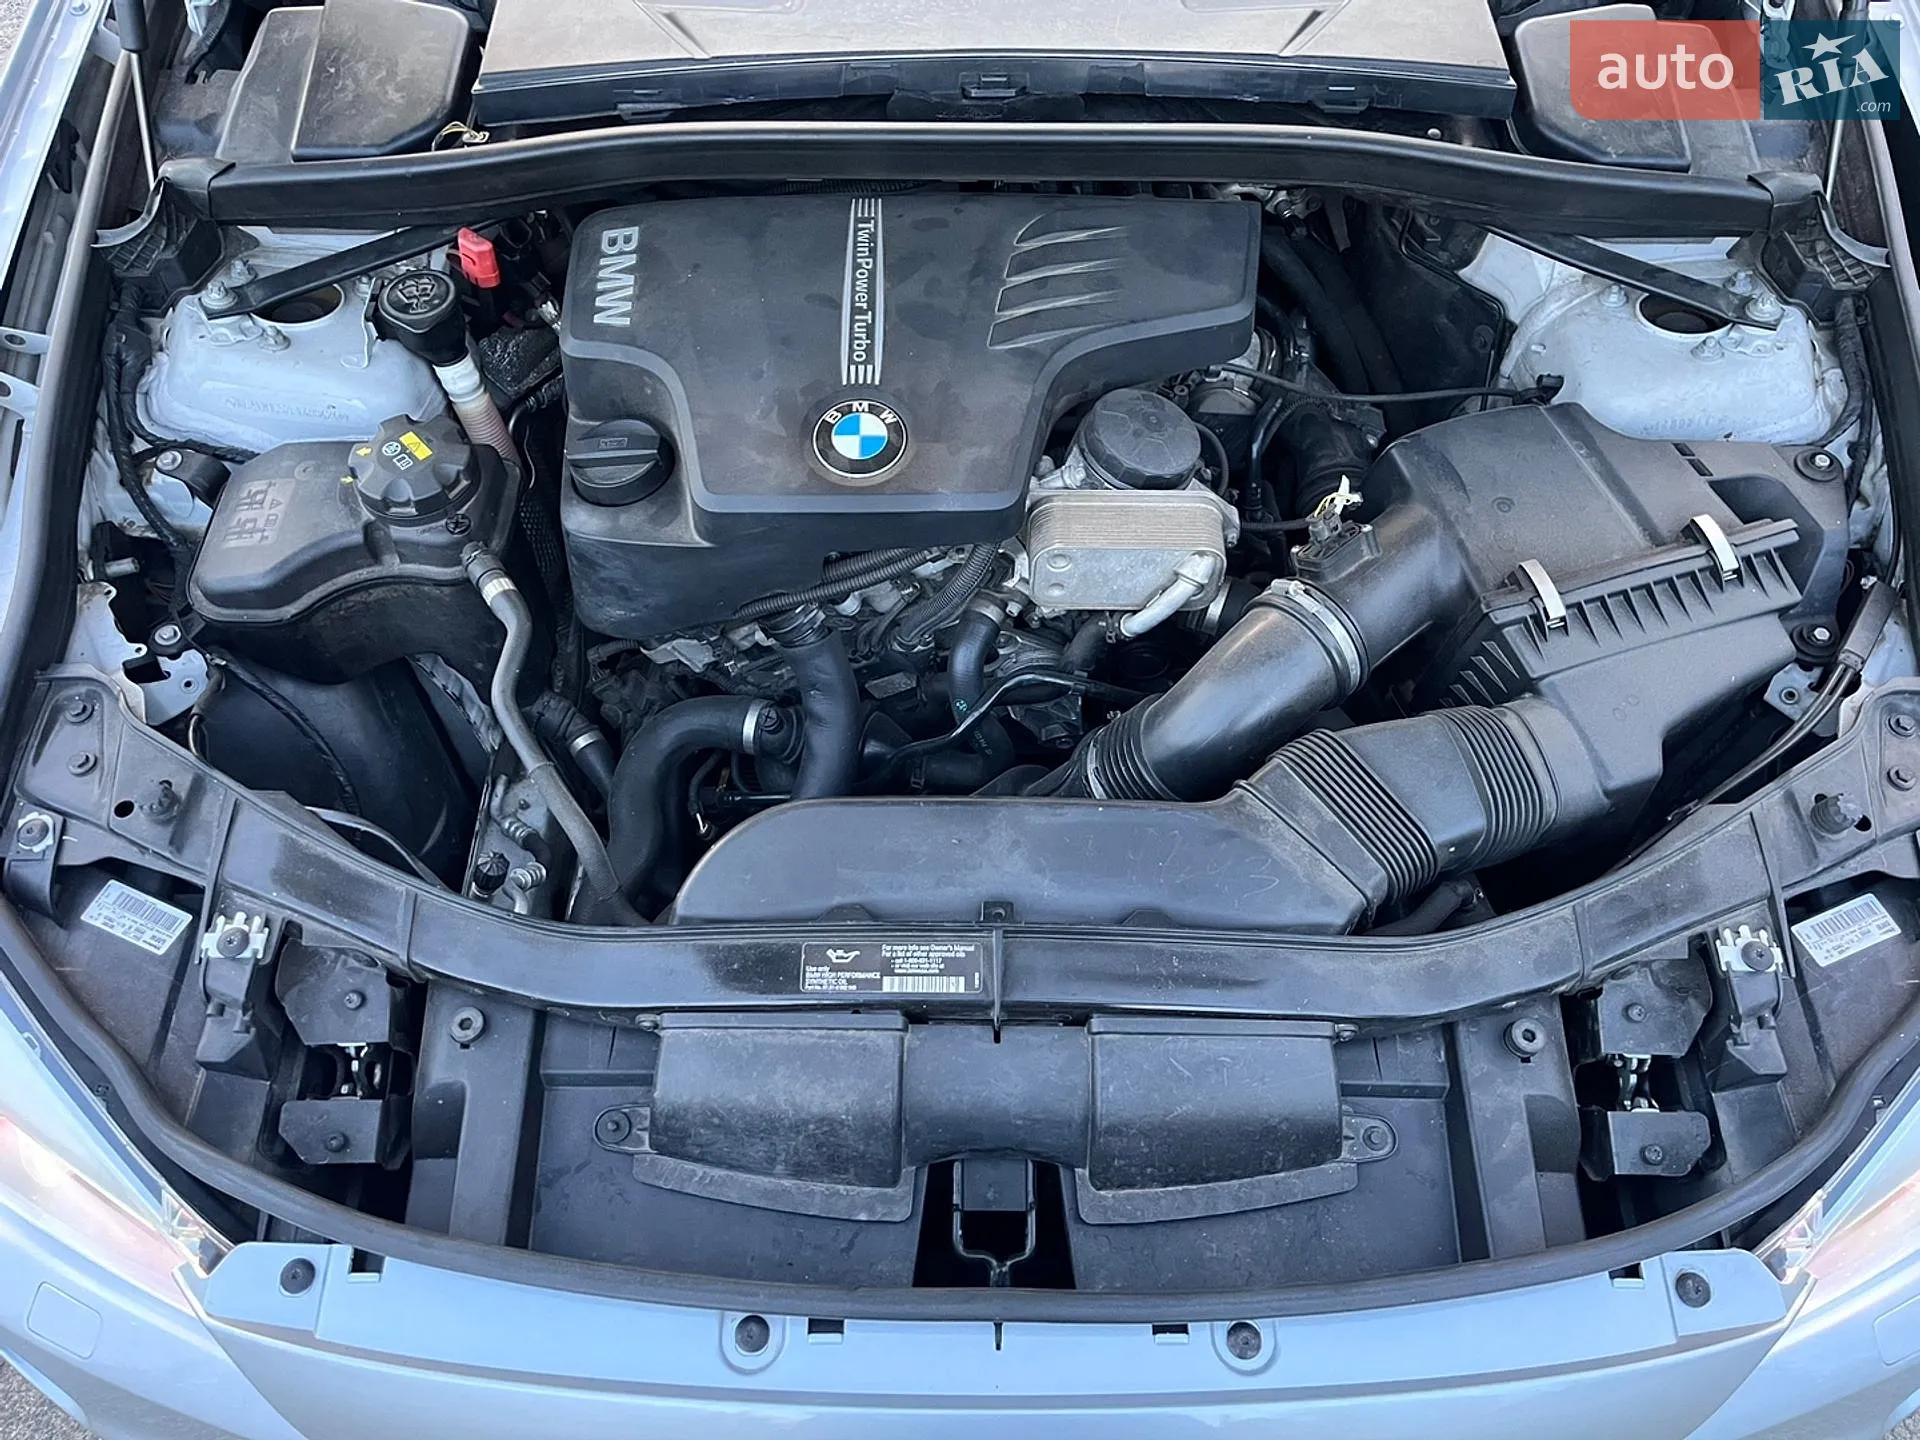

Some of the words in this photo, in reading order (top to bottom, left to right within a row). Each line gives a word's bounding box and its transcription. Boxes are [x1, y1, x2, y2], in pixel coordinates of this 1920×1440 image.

[593, 226, 639, 328] BMW
[854, 219, 874, 309] TwinPower
[853, 310, 873, 362] Turbo
